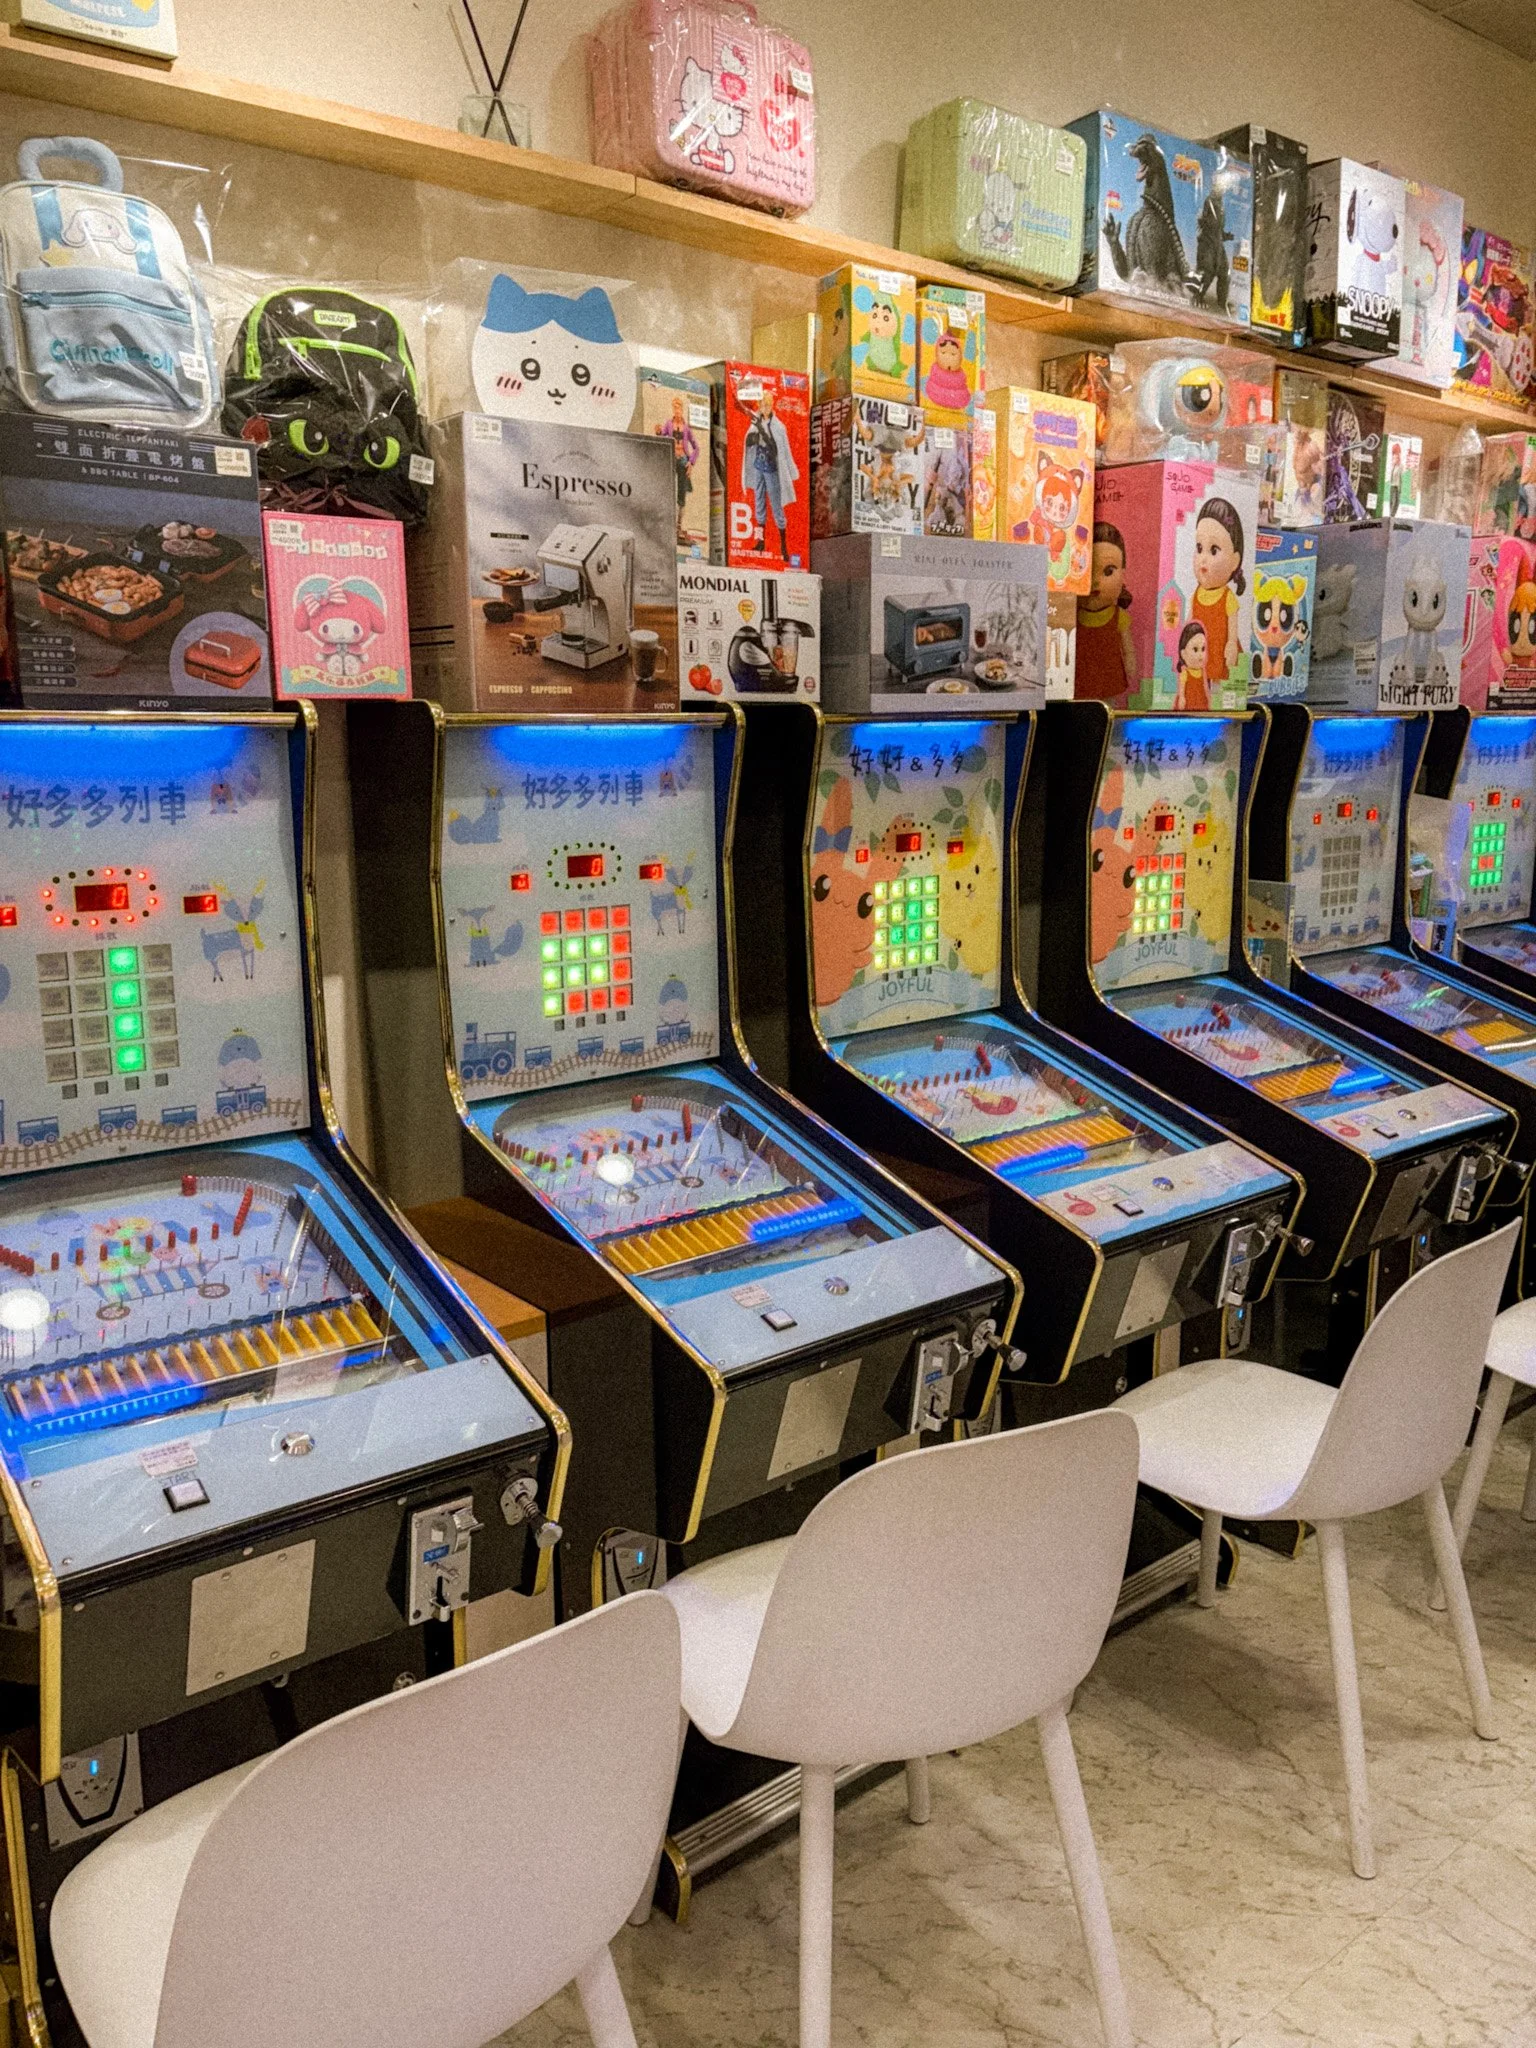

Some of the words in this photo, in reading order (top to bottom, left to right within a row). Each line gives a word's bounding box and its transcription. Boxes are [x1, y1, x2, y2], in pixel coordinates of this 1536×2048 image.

[1348, 285, 1394, 322] SNOOPY
[77, 428, 121, 441] ELECTRIC
[831, 400, 842, 459] ARTIST
[125, 434, 180, 448] TEPPANYAKI
[111, 469, 138, 480] TABLE
[521, 462, 633, 500] Espresso
[973, 558, 1014, 570] TOASTER
[679, 575, 750, 594] MONDIAL
[489, 684, 523, 694] ESPRESSO
[530, 685, 573, 695] CAPPUCCINO
[521, 770, 643, 810] 好多多列車
[2, 781, 187, 829] 好多多列車
[590, 857, 602, 876] 0
[111, 885, 127, 908] 0
[1134, 942, 1178, 962] JOYFUL
[878, 977, 935, 1001] JOYFUL
